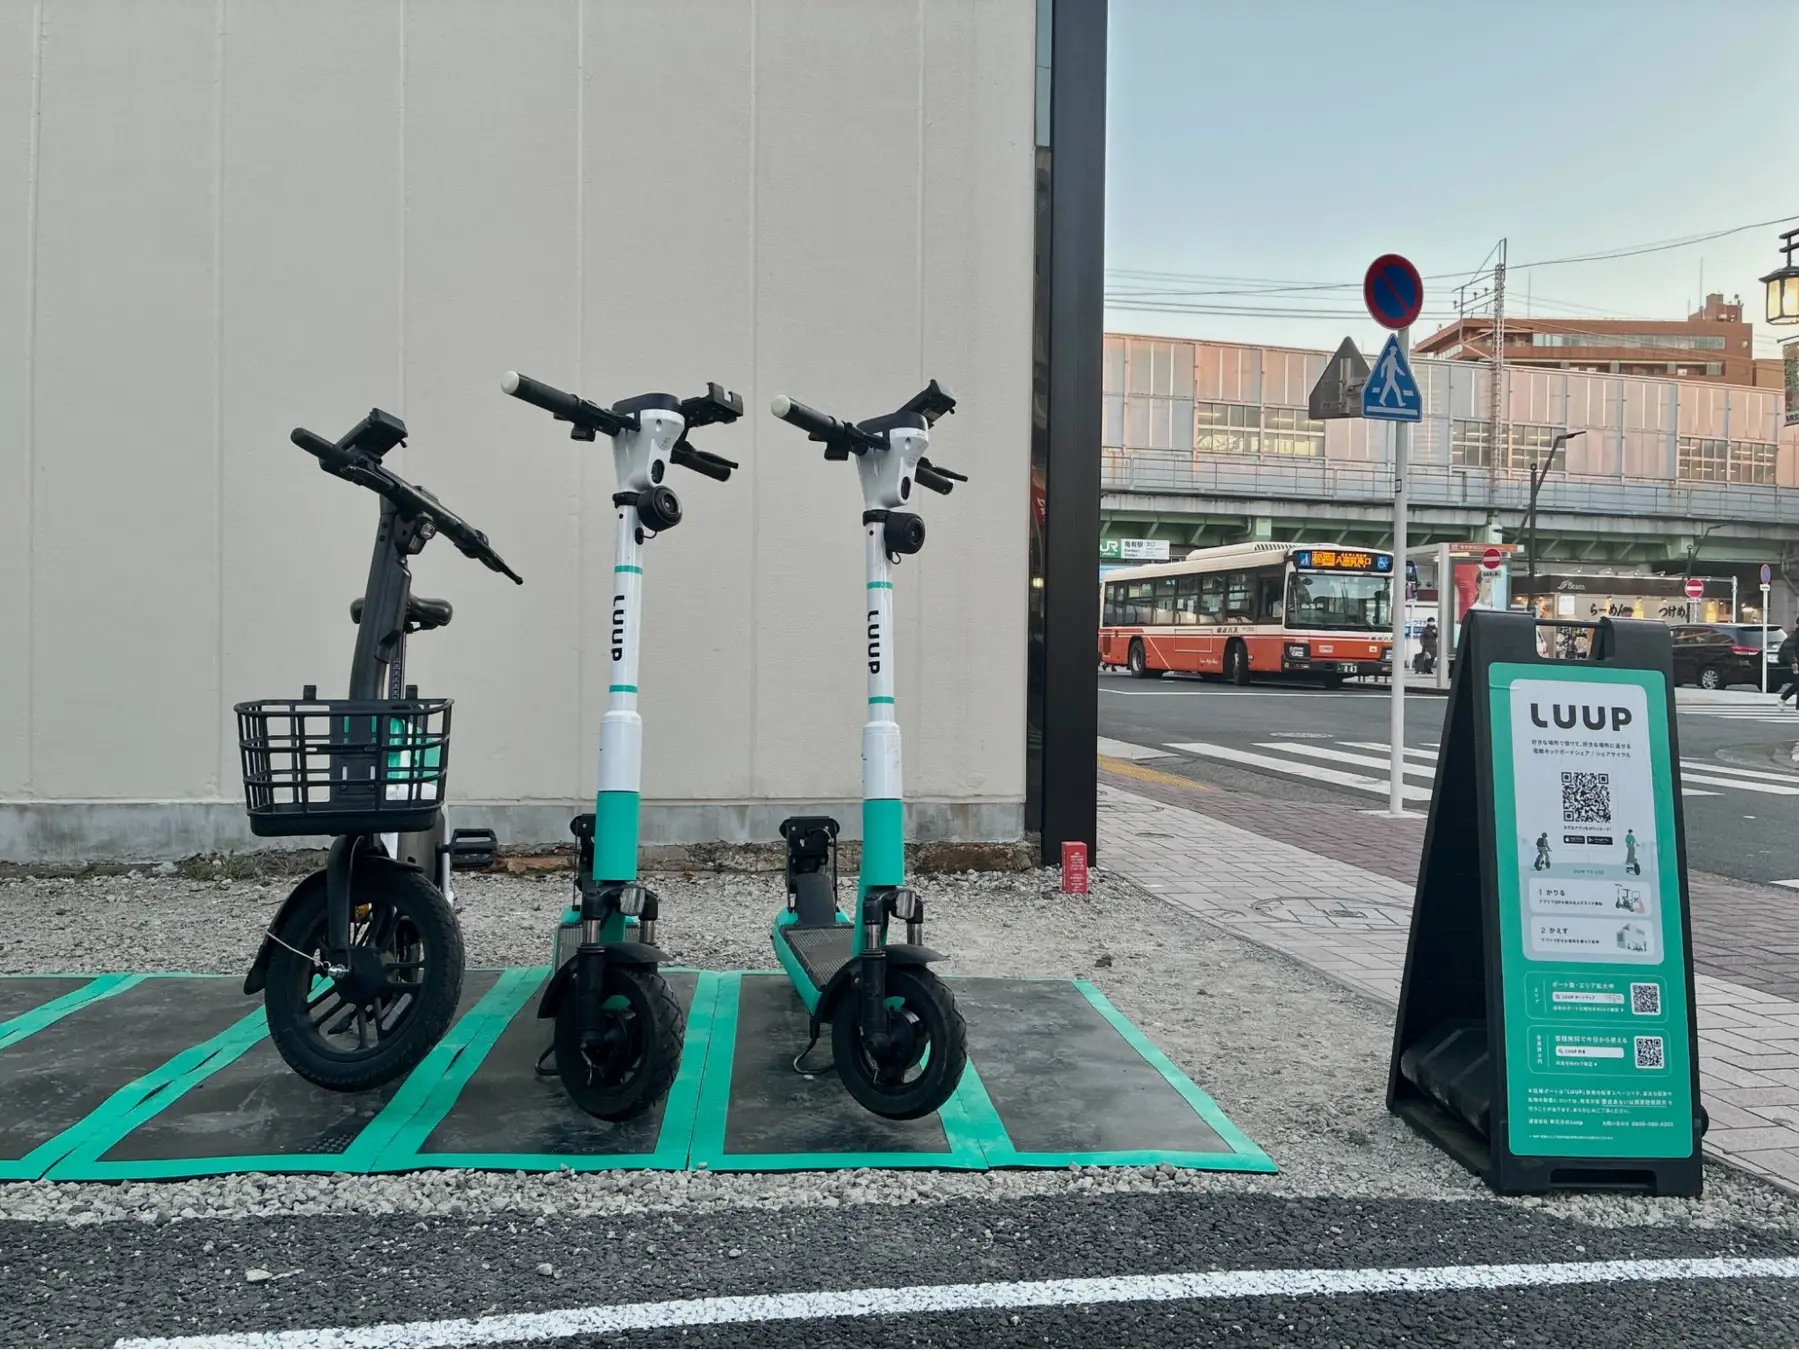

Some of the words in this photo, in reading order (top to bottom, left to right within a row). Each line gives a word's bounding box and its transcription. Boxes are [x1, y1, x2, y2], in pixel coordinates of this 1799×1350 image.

[1100, 541, 1118, 552] JR
[1568, 582, 1585, 590] Beans
[1659, 605, 1688, 616] つけめ
[611, 595, 625, 661] LUUP
[867, 610, 880, 674] LUUP
[1530, 703, 1632, 731] LUUP
